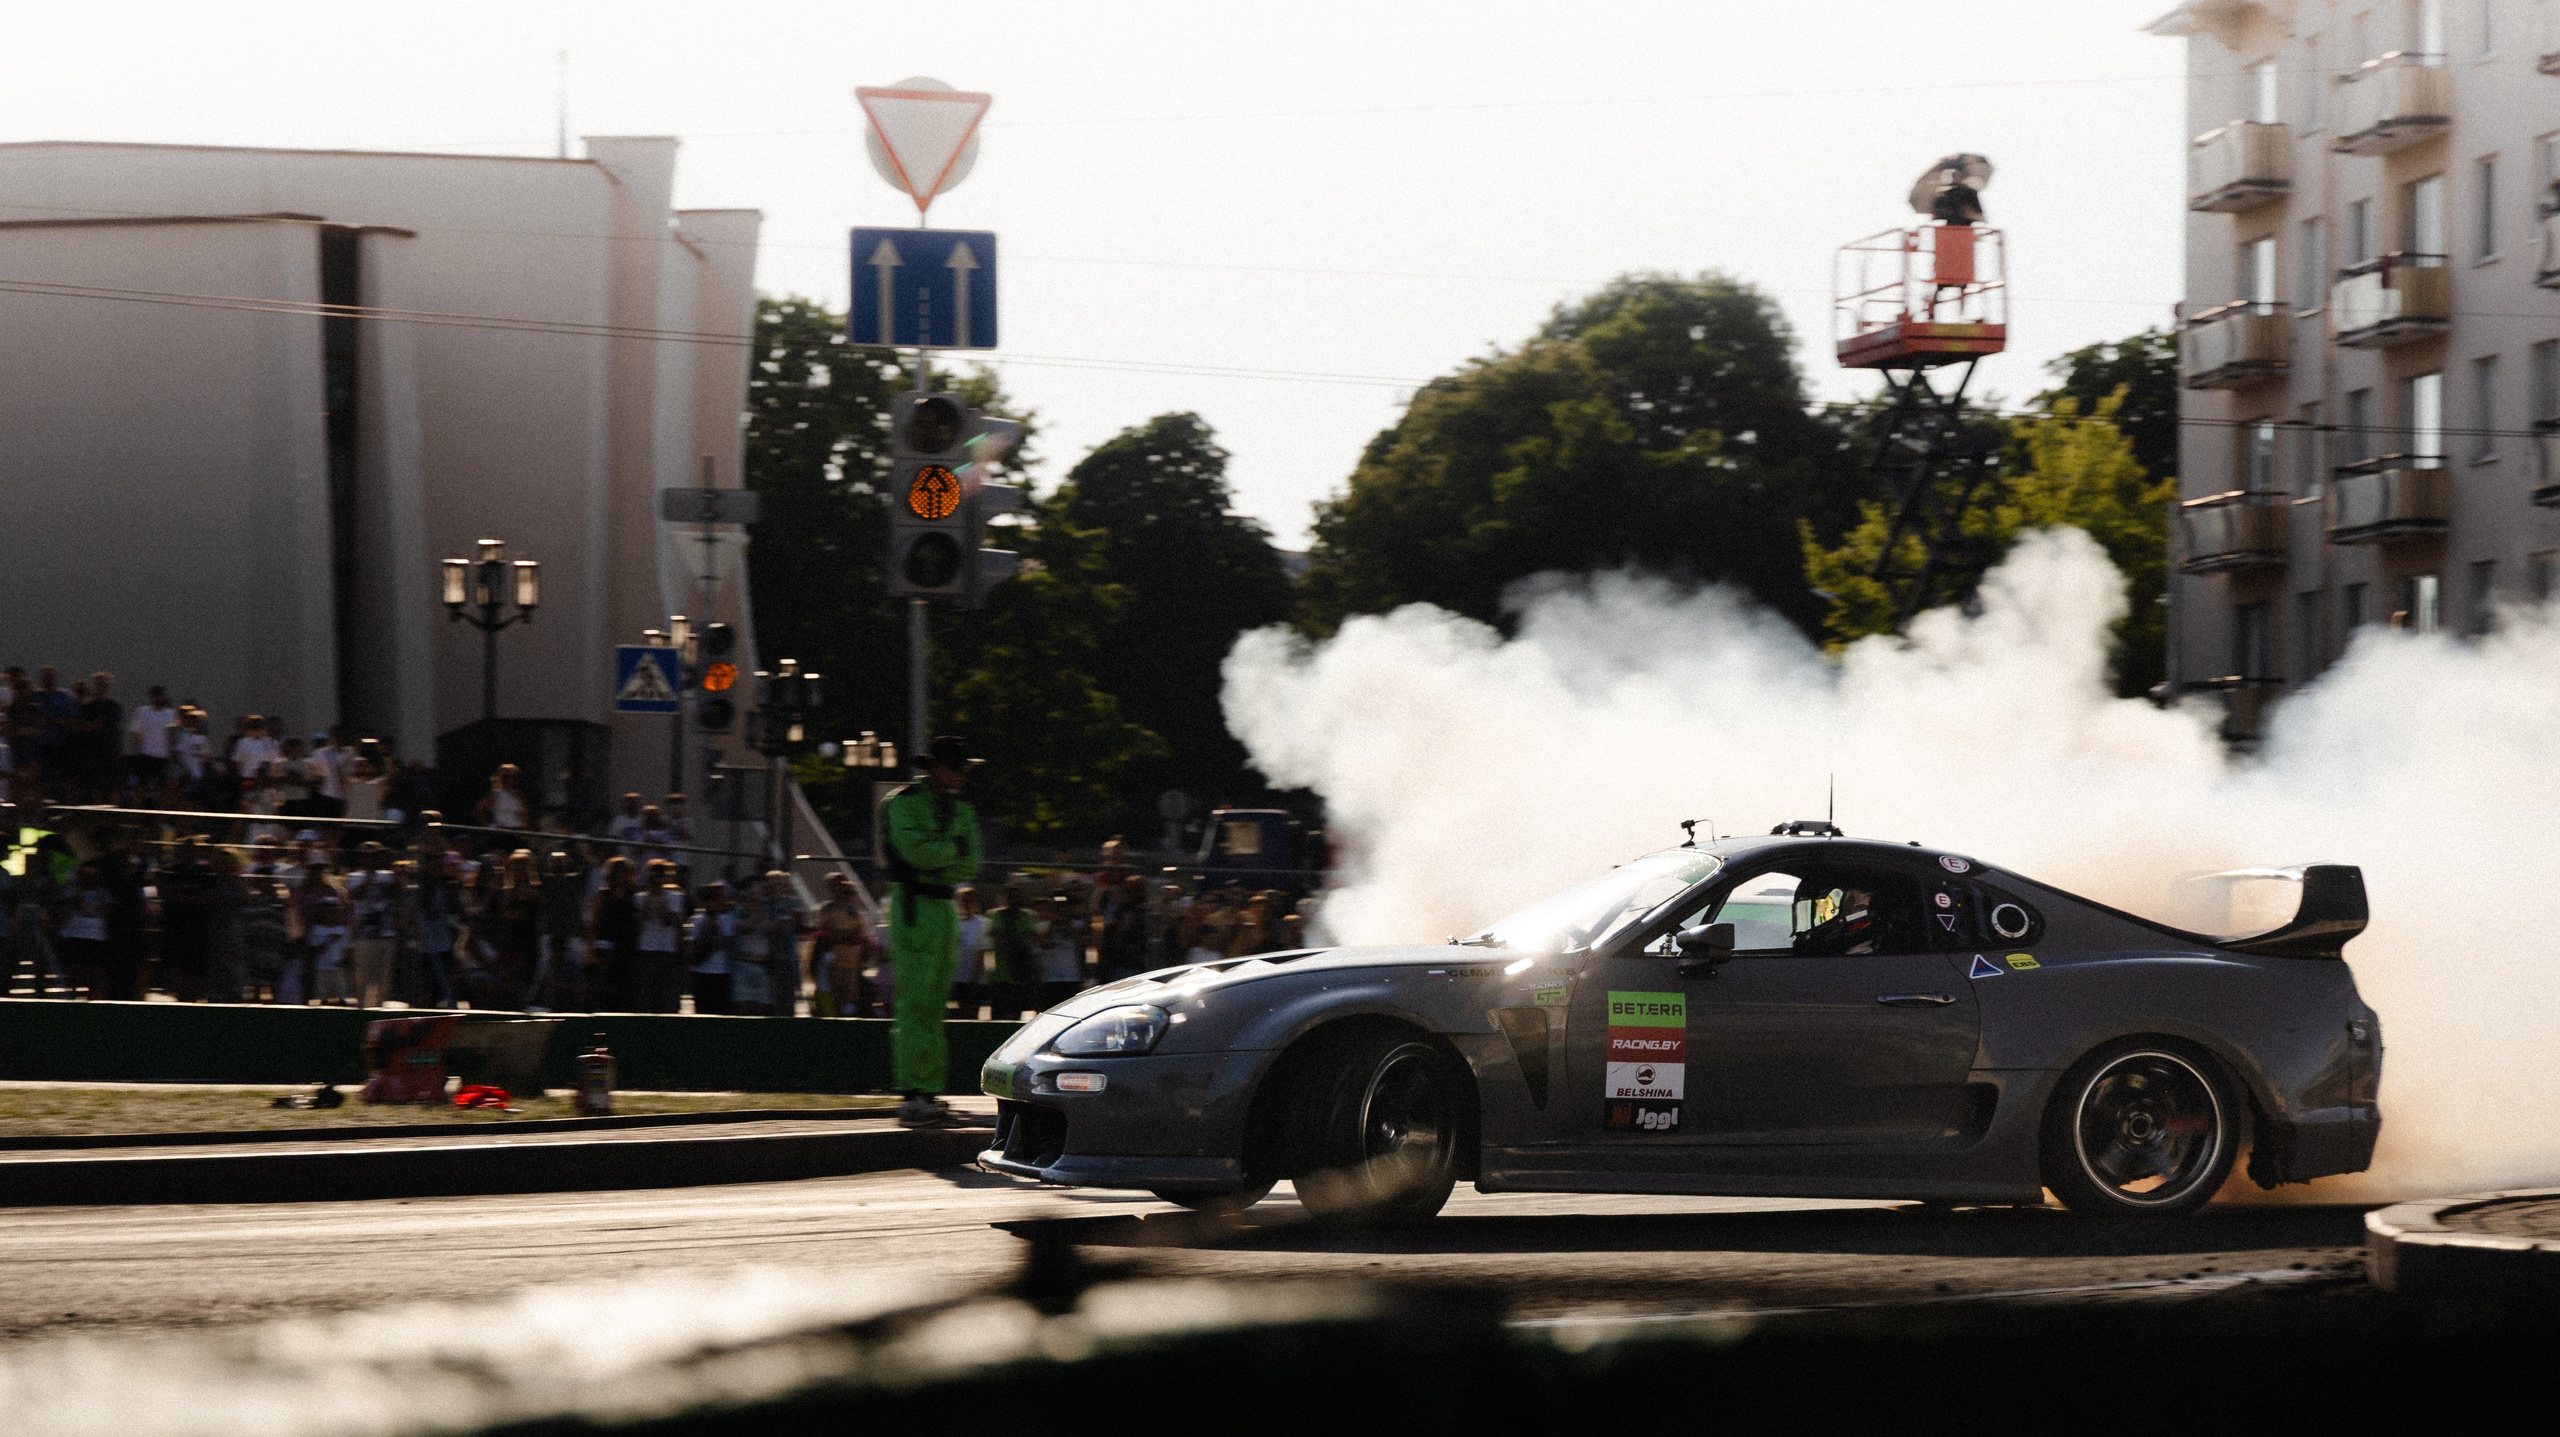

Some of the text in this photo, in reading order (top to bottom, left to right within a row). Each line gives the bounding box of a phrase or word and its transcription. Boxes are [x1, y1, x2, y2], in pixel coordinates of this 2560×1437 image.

[1939, 895, 1949, 905] E
[1612, 1039, 1682, 1051] RACING.BY
[1616, 1088, 1674, 1098] BELSHINA
